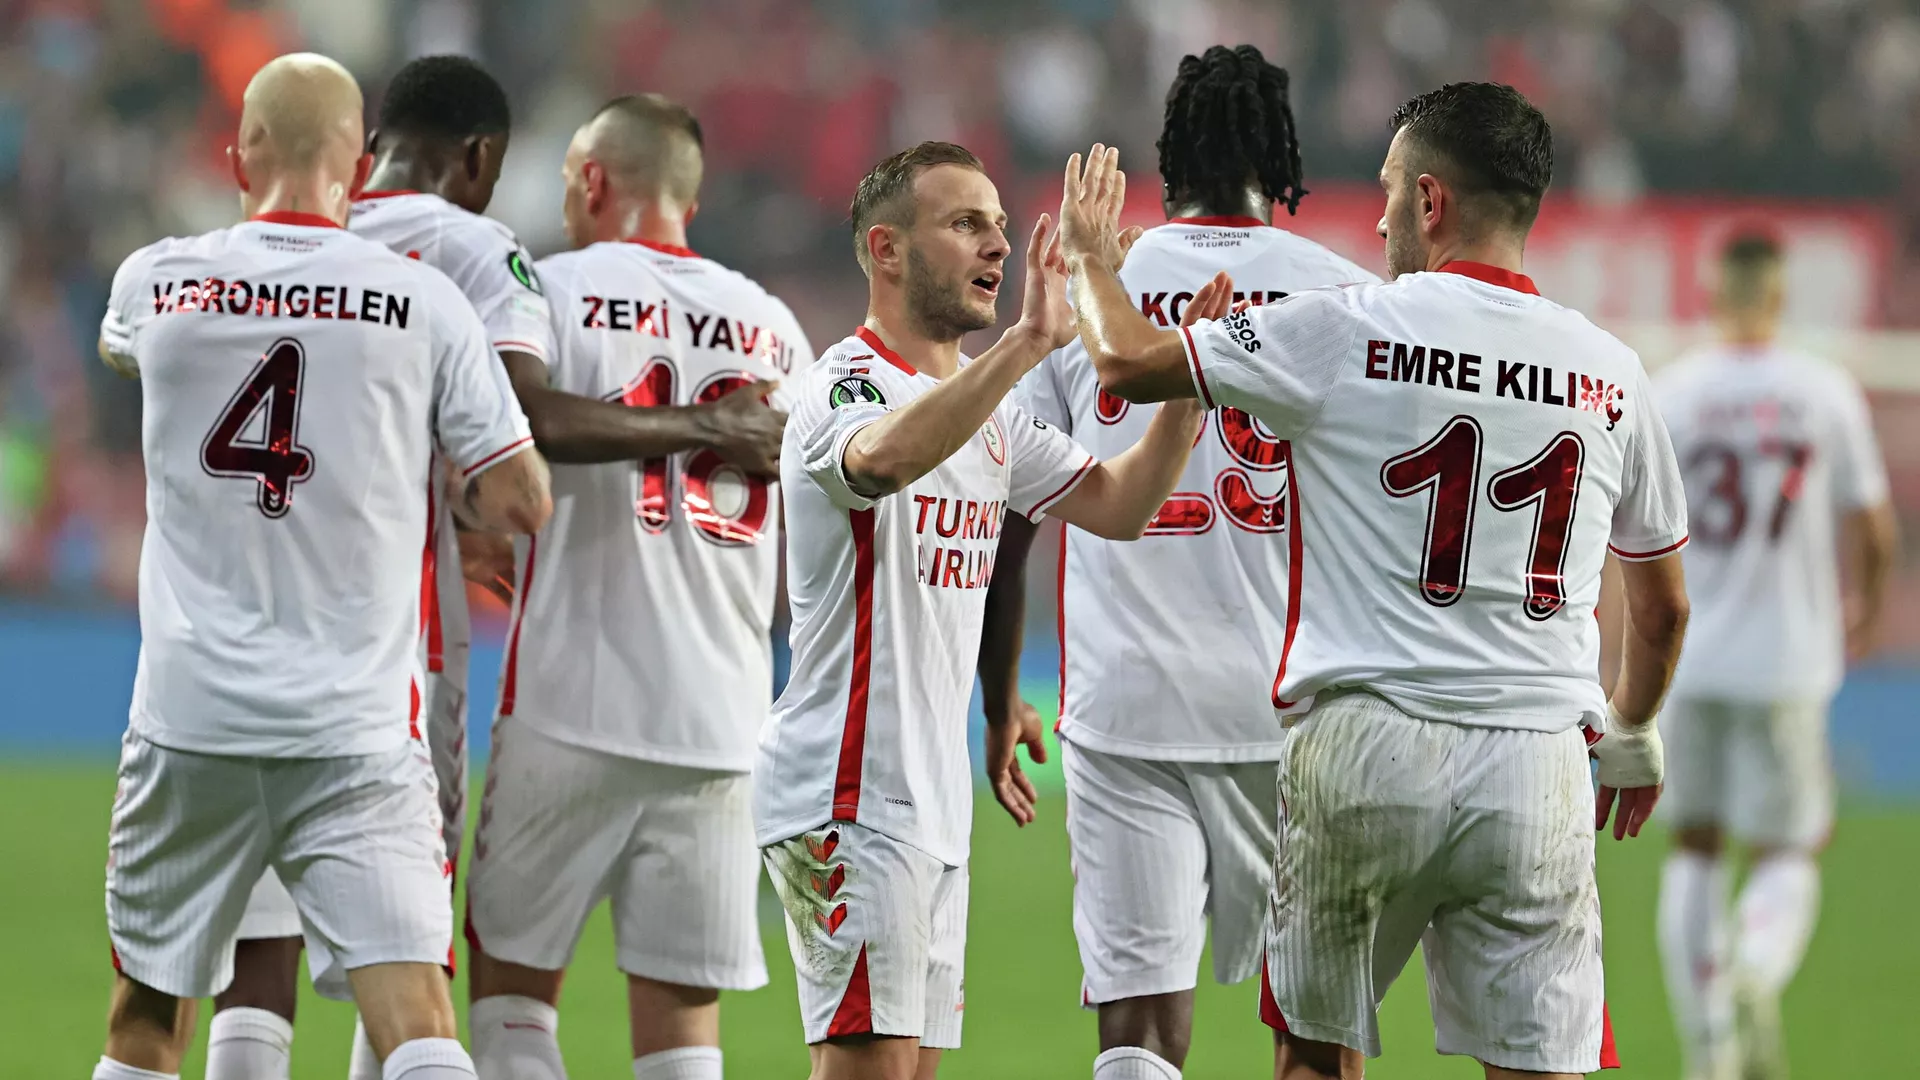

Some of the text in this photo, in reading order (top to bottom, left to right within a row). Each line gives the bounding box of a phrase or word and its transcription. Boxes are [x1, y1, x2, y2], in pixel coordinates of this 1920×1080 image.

[1206, 240, 1242, 248] EUROPE
[152, 275, 412, 330] V.DRONGELEN
[582, 296, 671, 341] ZEKİ
[200, 336, 315, 519] 4
[1365, 339, 1481, 394] EMRE
[1496, 360, 1625, 433] KILINÇ
[1380, 414, 1585, 622] 11
[1686, 434, 1815, 548] 37
